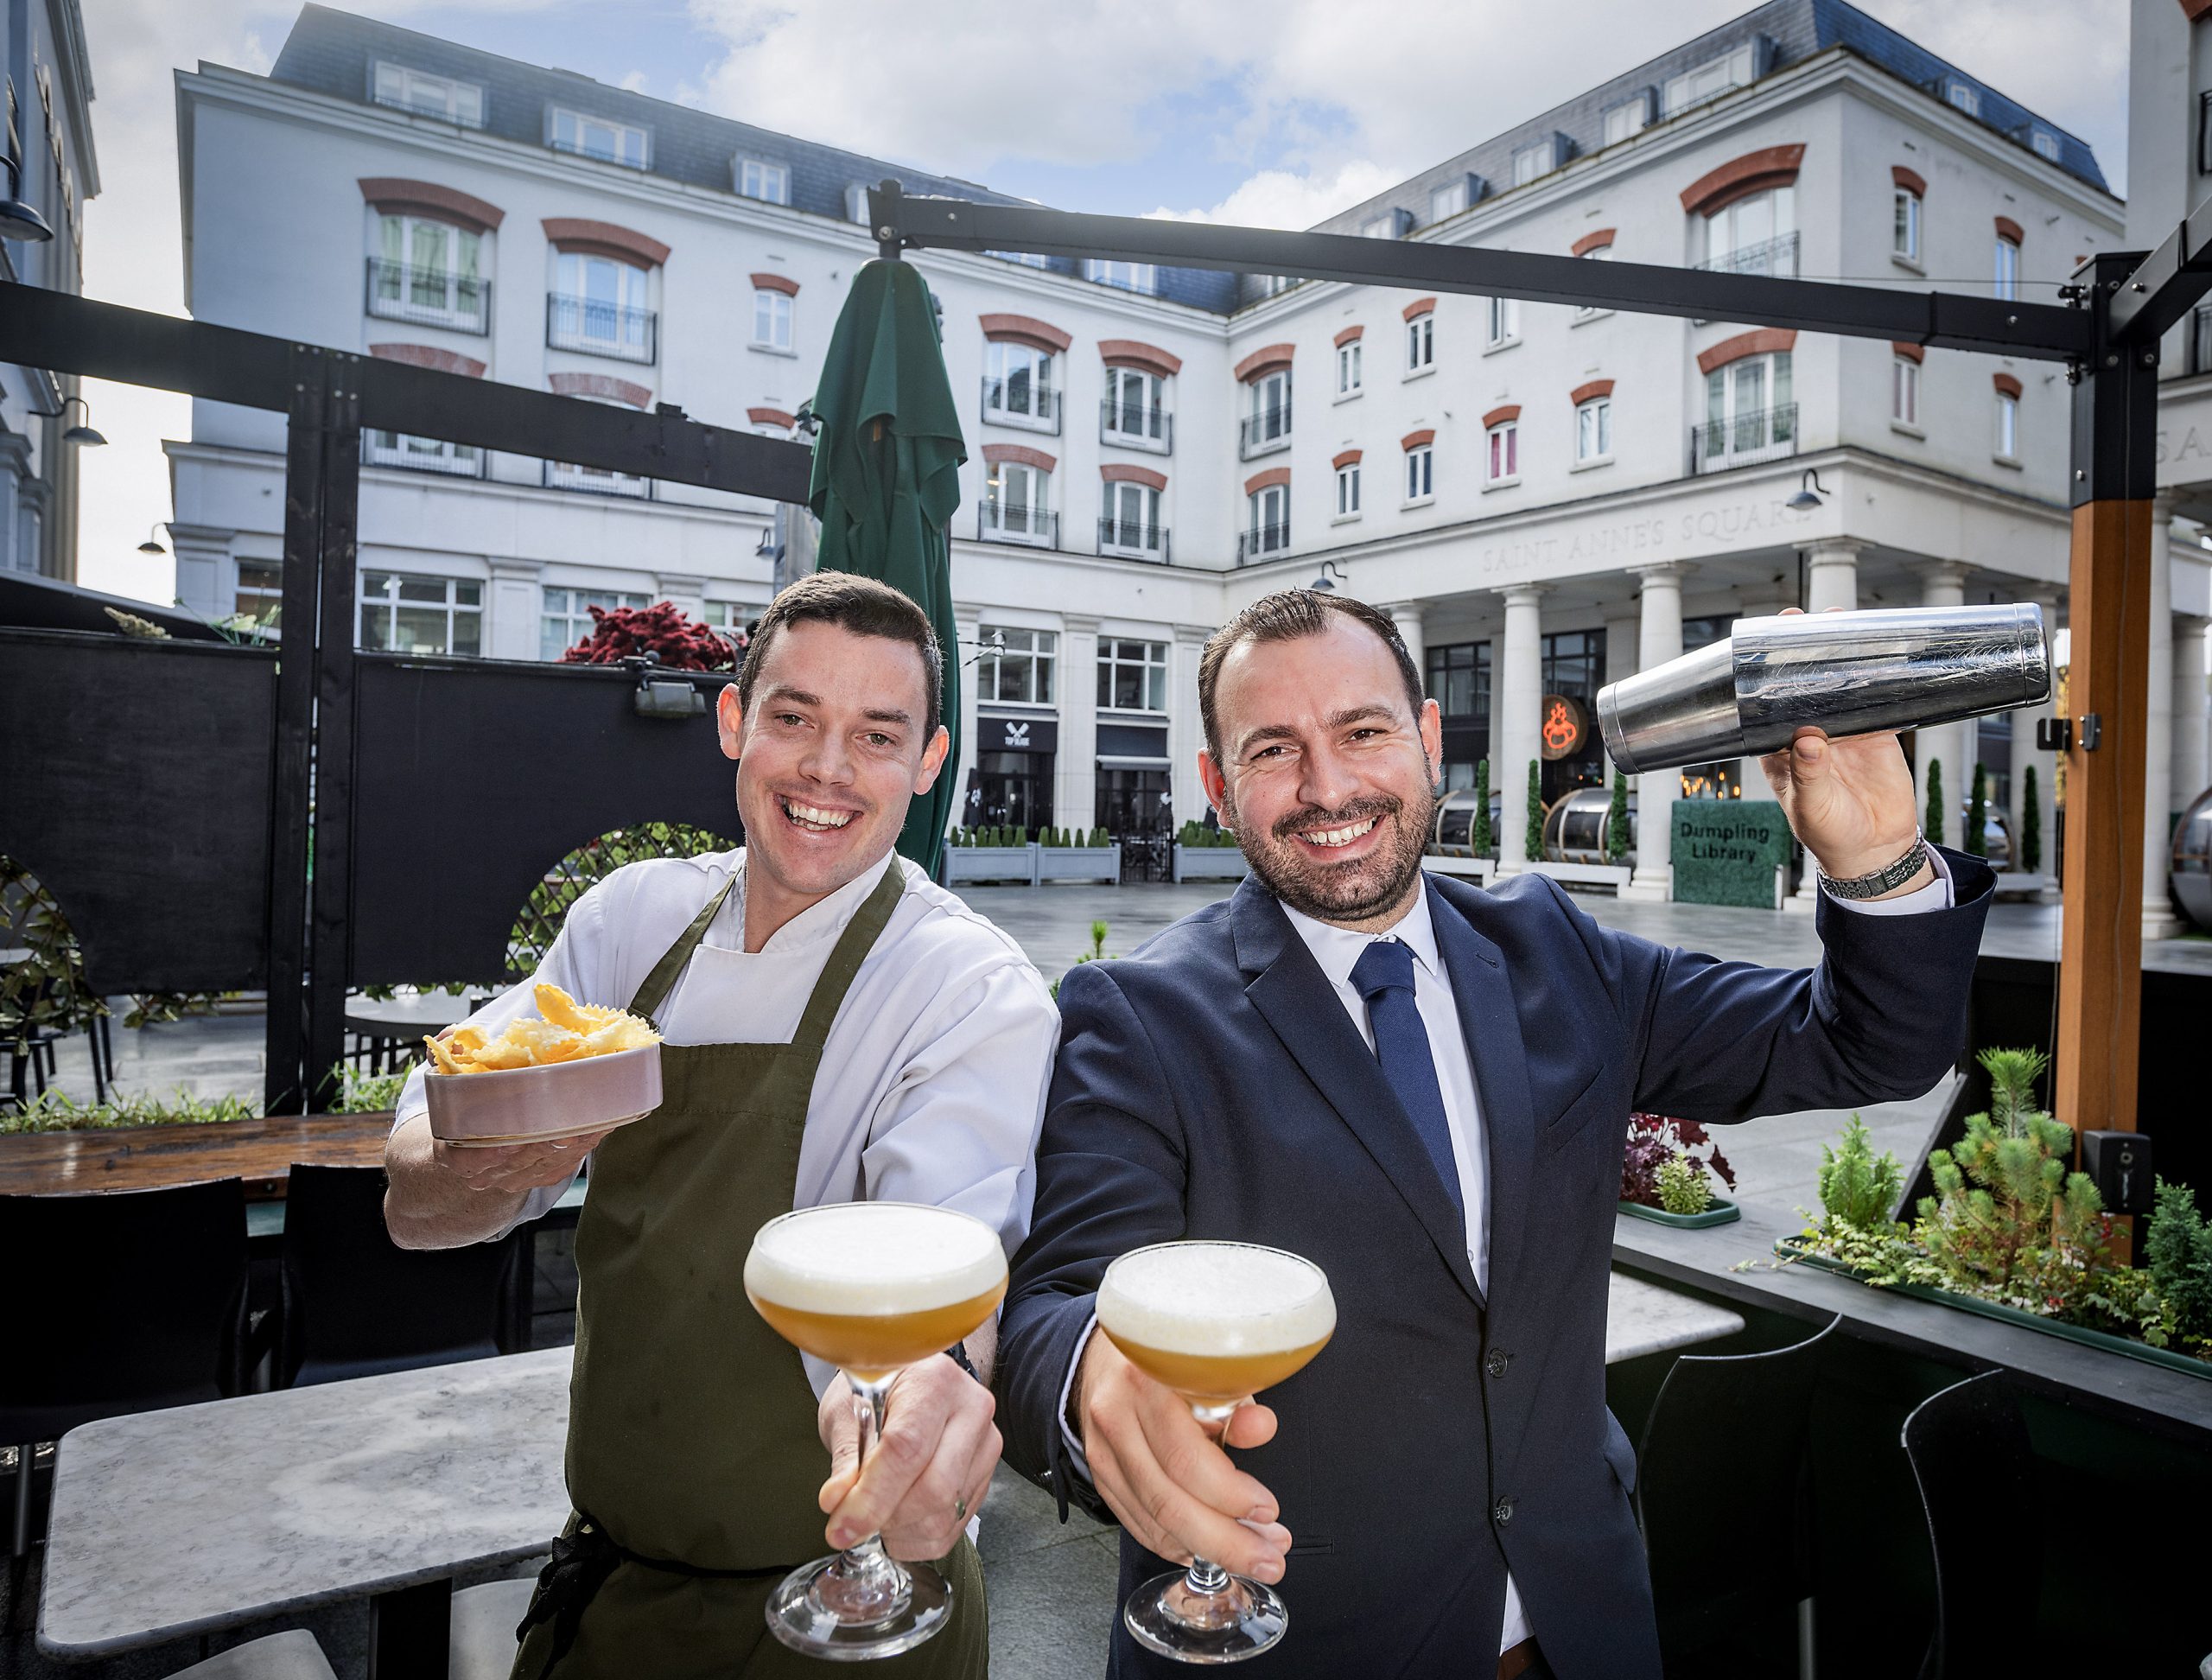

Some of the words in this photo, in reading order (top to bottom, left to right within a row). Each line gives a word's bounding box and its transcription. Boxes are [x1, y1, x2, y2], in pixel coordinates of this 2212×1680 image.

[1483, 539, 1558, 572] SAINT
[1568, 520, 1665, 560] ANNE'S
[1681, 823, 1770, 843] Dumpling
[1693, 843, 1756, 862] Library
